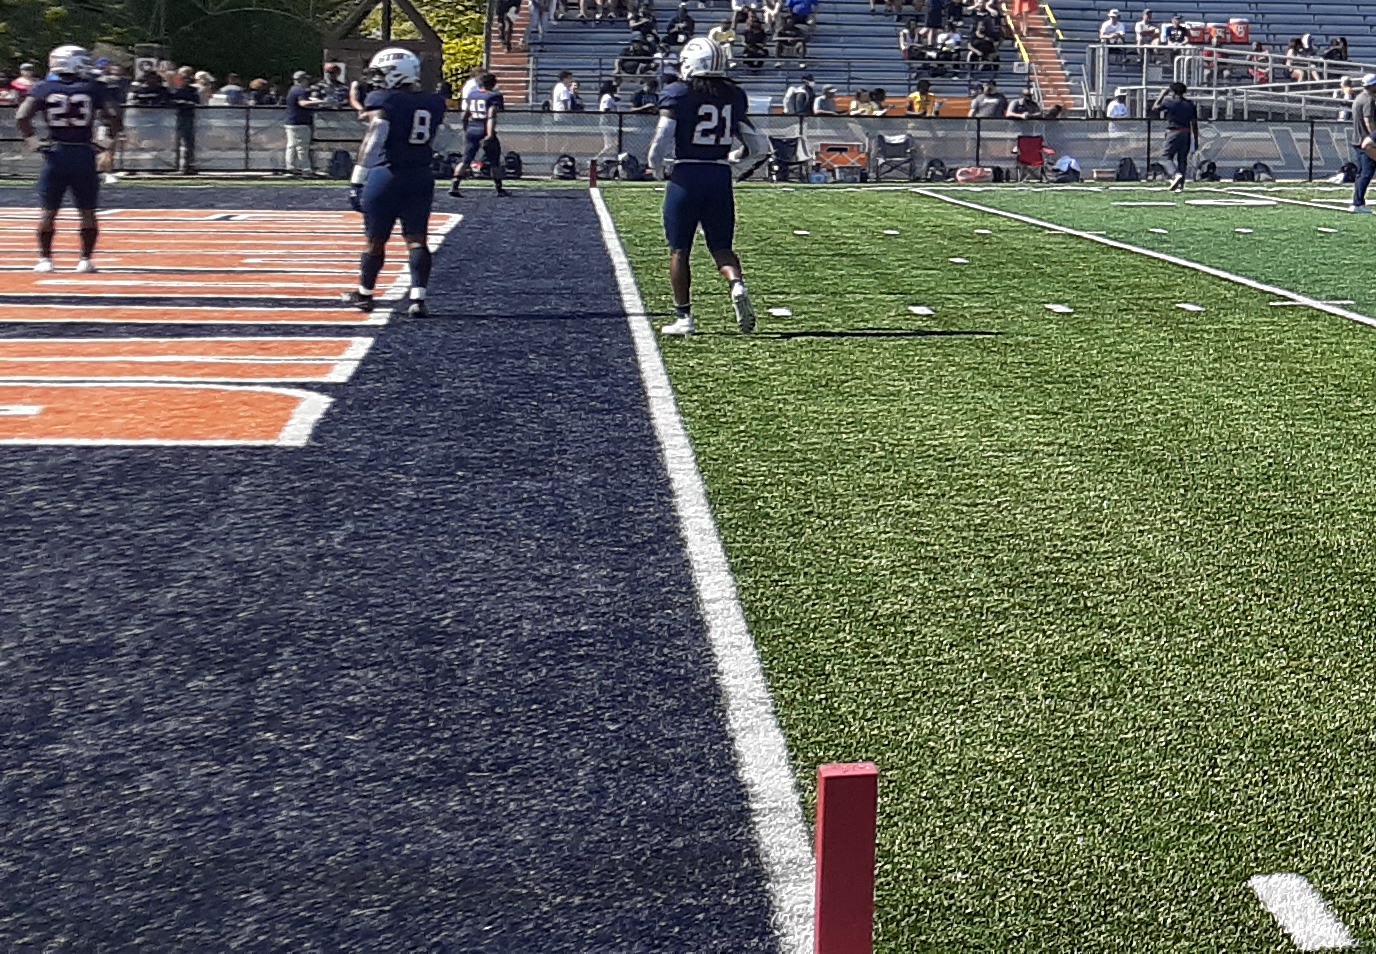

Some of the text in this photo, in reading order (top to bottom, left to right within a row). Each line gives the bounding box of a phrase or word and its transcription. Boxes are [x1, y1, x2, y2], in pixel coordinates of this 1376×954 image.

[45, 92, 91, 127] 23
[408, 109, 433, 145] 8
[692, 104, 733, 145] 21
